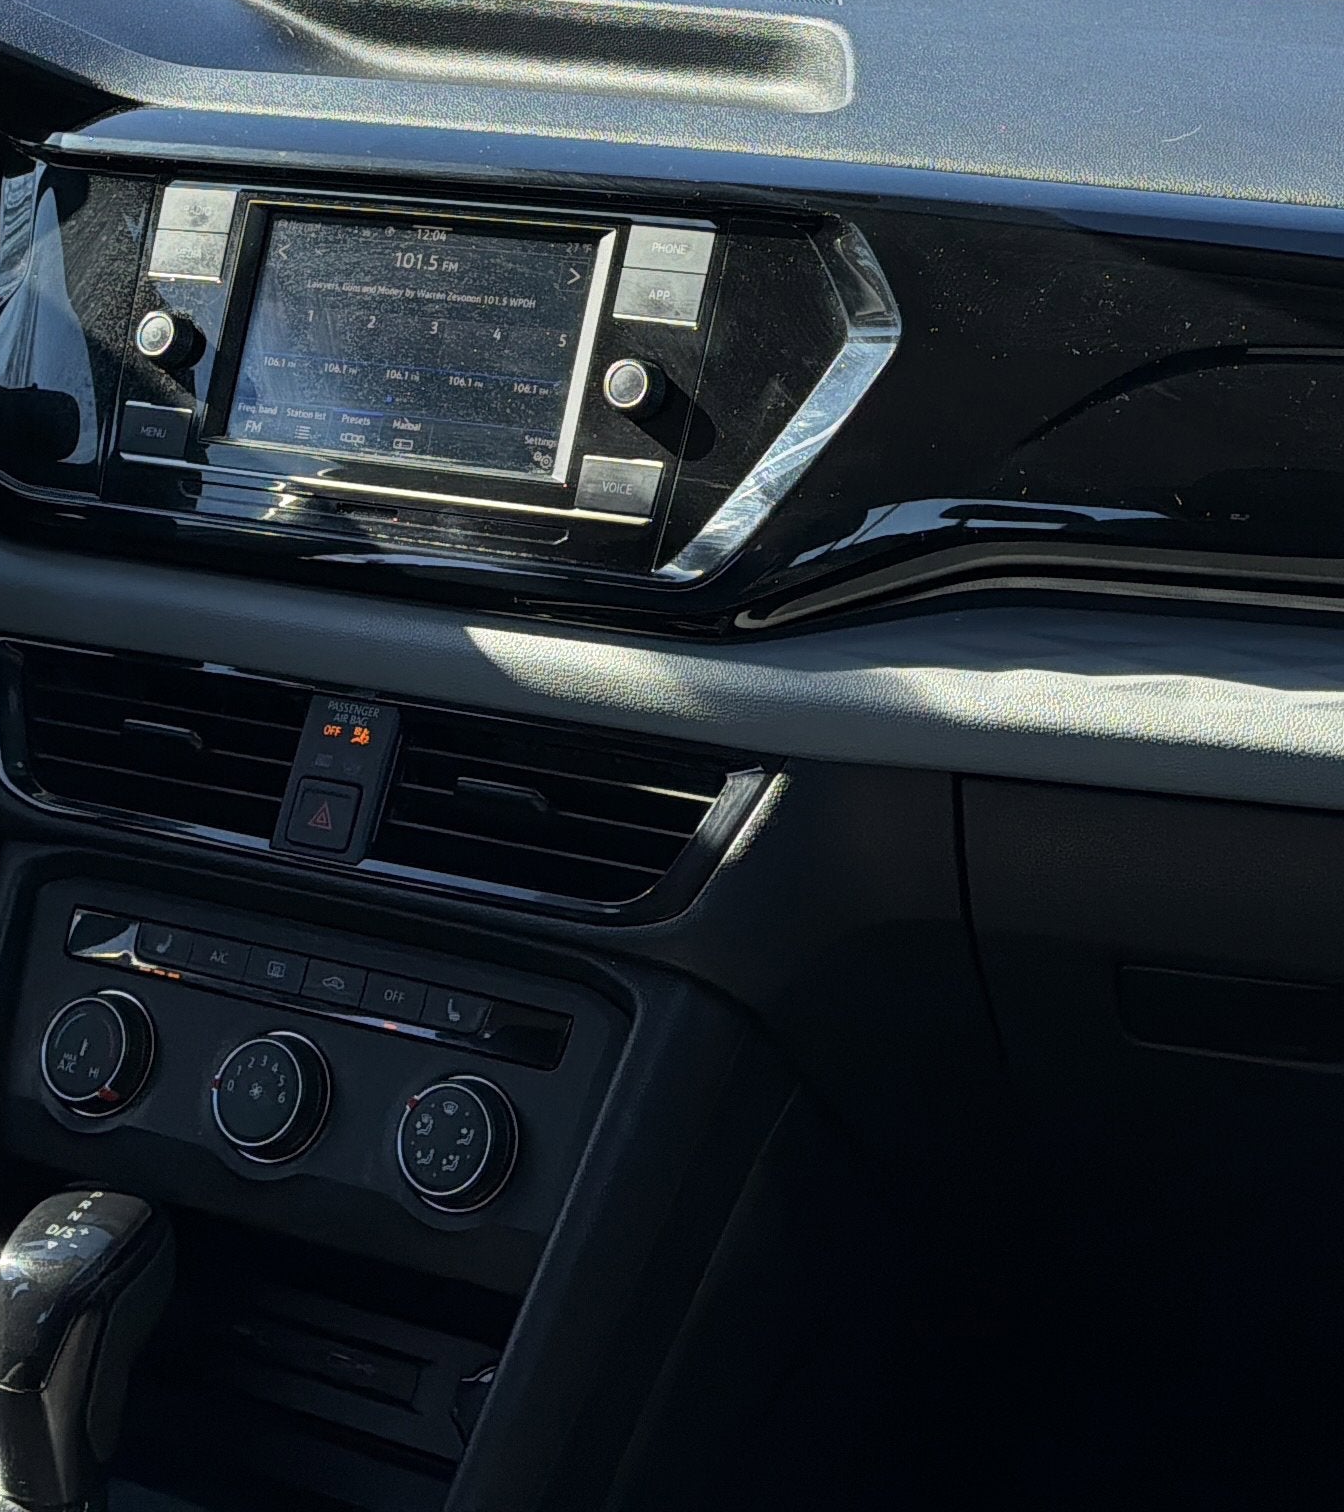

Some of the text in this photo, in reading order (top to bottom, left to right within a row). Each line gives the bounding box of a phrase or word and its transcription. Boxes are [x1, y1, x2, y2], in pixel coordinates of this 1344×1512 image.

[416, 229, 447, 242] 12:04
[651, 243, 688, 255] PHONE
[394, 252, 458, 272] 101.5 FM
[362, 285, 377, 293] and
[378, 286, 404, 297] Money
[405, 288, 416, 299] by
[417, 289, 446, 299] Warren
[484, 295, 507, 306] 101.5
[510, 297, 536, 308] WPDH
[649, 289, 670, 301] APP
[308, 310, 314, 322] 1
[367, 316, 376, 328] 2
[430, 321, 438, 334] 3
[493, 328, 501, 340] 4
[558, 334, 567, 348] 5
[264, 356, 286, 368] 106.1
[324, 363, 347, 374] 106.1
[386, 369, 408, 380] 106.1
[449, 376, 472, 387] 106.1
[513, 383, 537, 394] 106.1
[286, 408, 314, 419] Station
[341, 414, 371, 426] Presets
[393, 419, 422, 432] Manual
[140, 426, 167, 438] MENU
[244, 420, 262, 433] FM
[602, 481, 633, 496] VOICE
[328, 701, 380, 718] PASSENGER
[333, 713, 369, 727] AIR BAG
[323, 724, 342, 737] OFF
[210, 950, 229, 964] A/C
[384, 989, 405, 1003] OFF
[63, 1052, 77, 1062] MAX
[247, 1057, 255, 1069] 2
[260, 1055, 268, 1067] 3
[57, 1061, 100, 1079] A/C HI
[236, 1065, 242, 1076] 1
[271, 1063, 279, 1073] 4
[227, 1080, 235, 1091] 0
[278, 1075, 286, 1087] 5
[278, 1091, 286, 1103] 6
[78, 1200, 92, 1210] R
[66, 1211, 83, 1221] N
[45, 1223, 76, 1239] D/S
